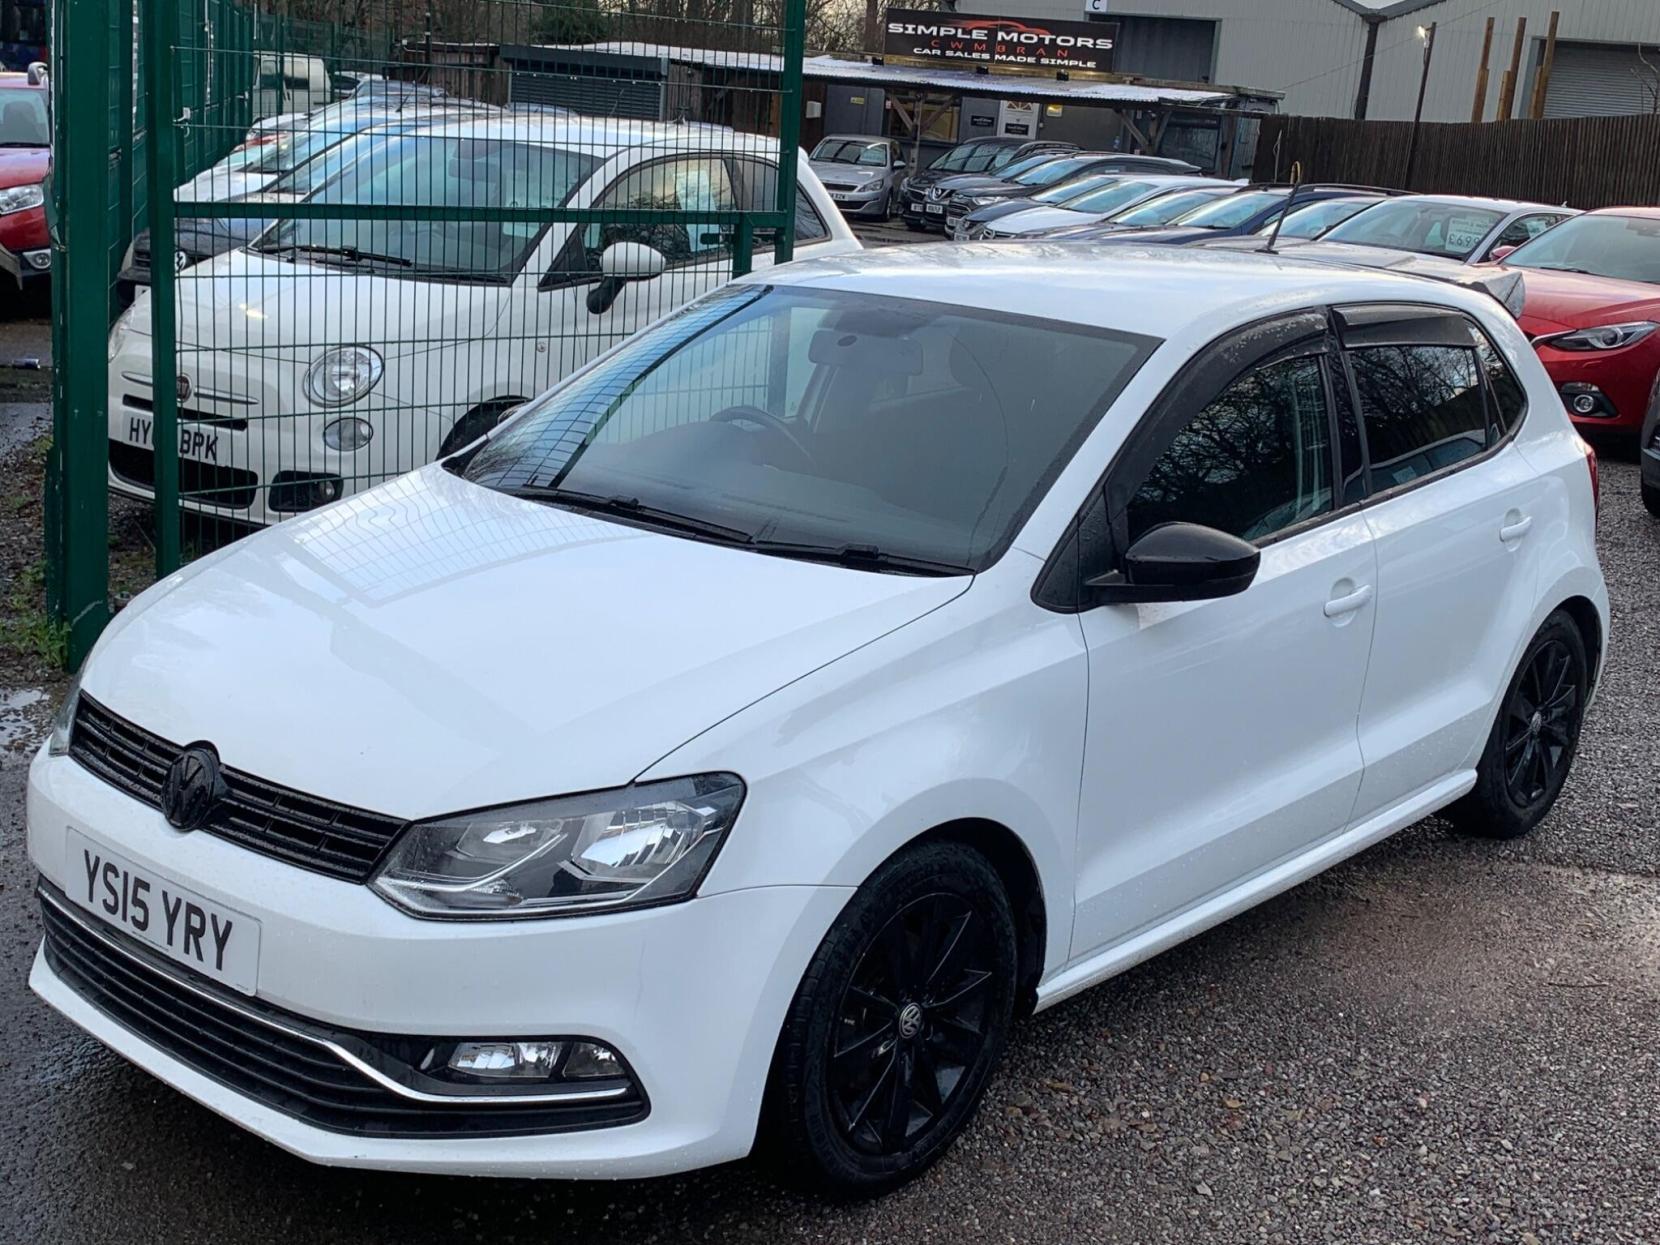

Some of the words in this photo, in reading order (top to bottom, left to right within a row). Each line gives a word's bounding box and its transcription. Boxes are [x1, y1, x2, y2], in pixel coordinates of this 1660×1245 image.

[1091, 0, 1101, 10] C
[888, 22, 988, 40] SIMPLE
[997, 31, 1113, 49] MOTORS
[913, 47, 942, 56] CAR
[945, 49, 991, 60] SALES
[994, 54, 1037, 64] MADE
[1040, 58, 1097, 69] SIMPLE
[179, 429, 219, 461] BPK
[84, 849, 150, 932] YS15
[162, 889, 233, 971] YRY
